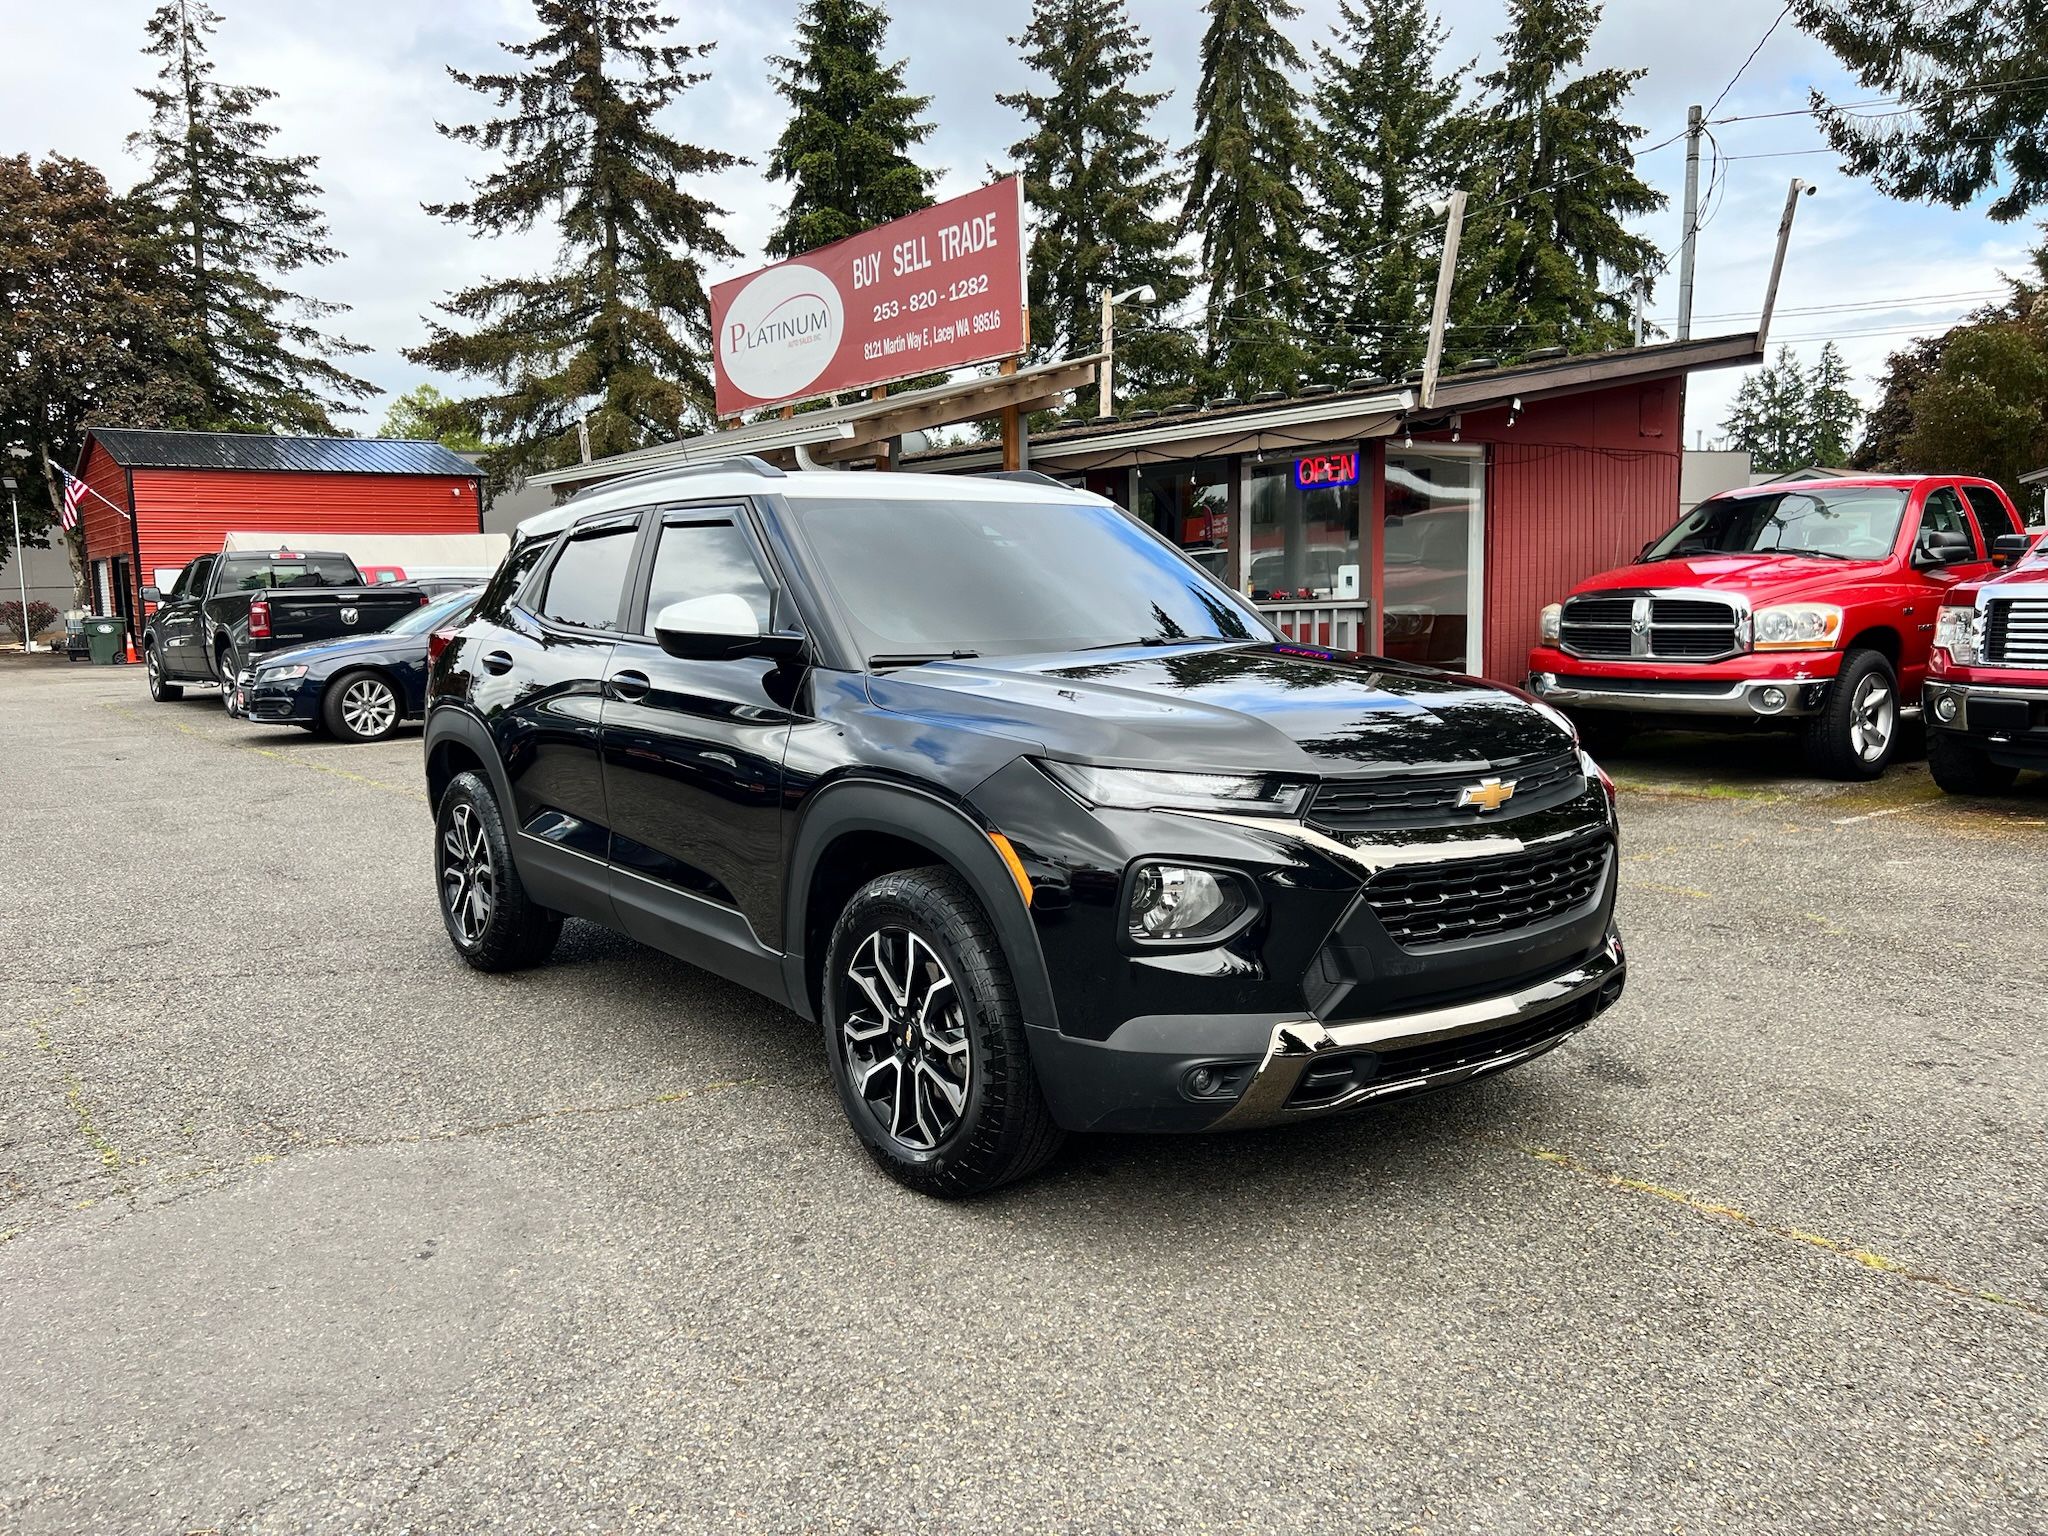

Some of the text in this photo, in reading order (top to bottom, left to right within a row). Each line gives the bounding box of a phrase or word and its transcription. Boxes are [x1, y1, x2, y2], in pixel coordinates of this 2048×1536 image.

[853, 212, 997, 290] BUY SELL TRADE
[730, 310, 827, 353] PLATINUM
[864, 342, 883, 360] 8121
[883, 335, 906, 356] Martin
[906, 331, 922, 351] Way
[933, 325, 955, 343] Lacey
[955, 318, 970, 338] WA
[972, 309, 1001, 334] 98516
[1299, 454, 1355, 484] OPEN
